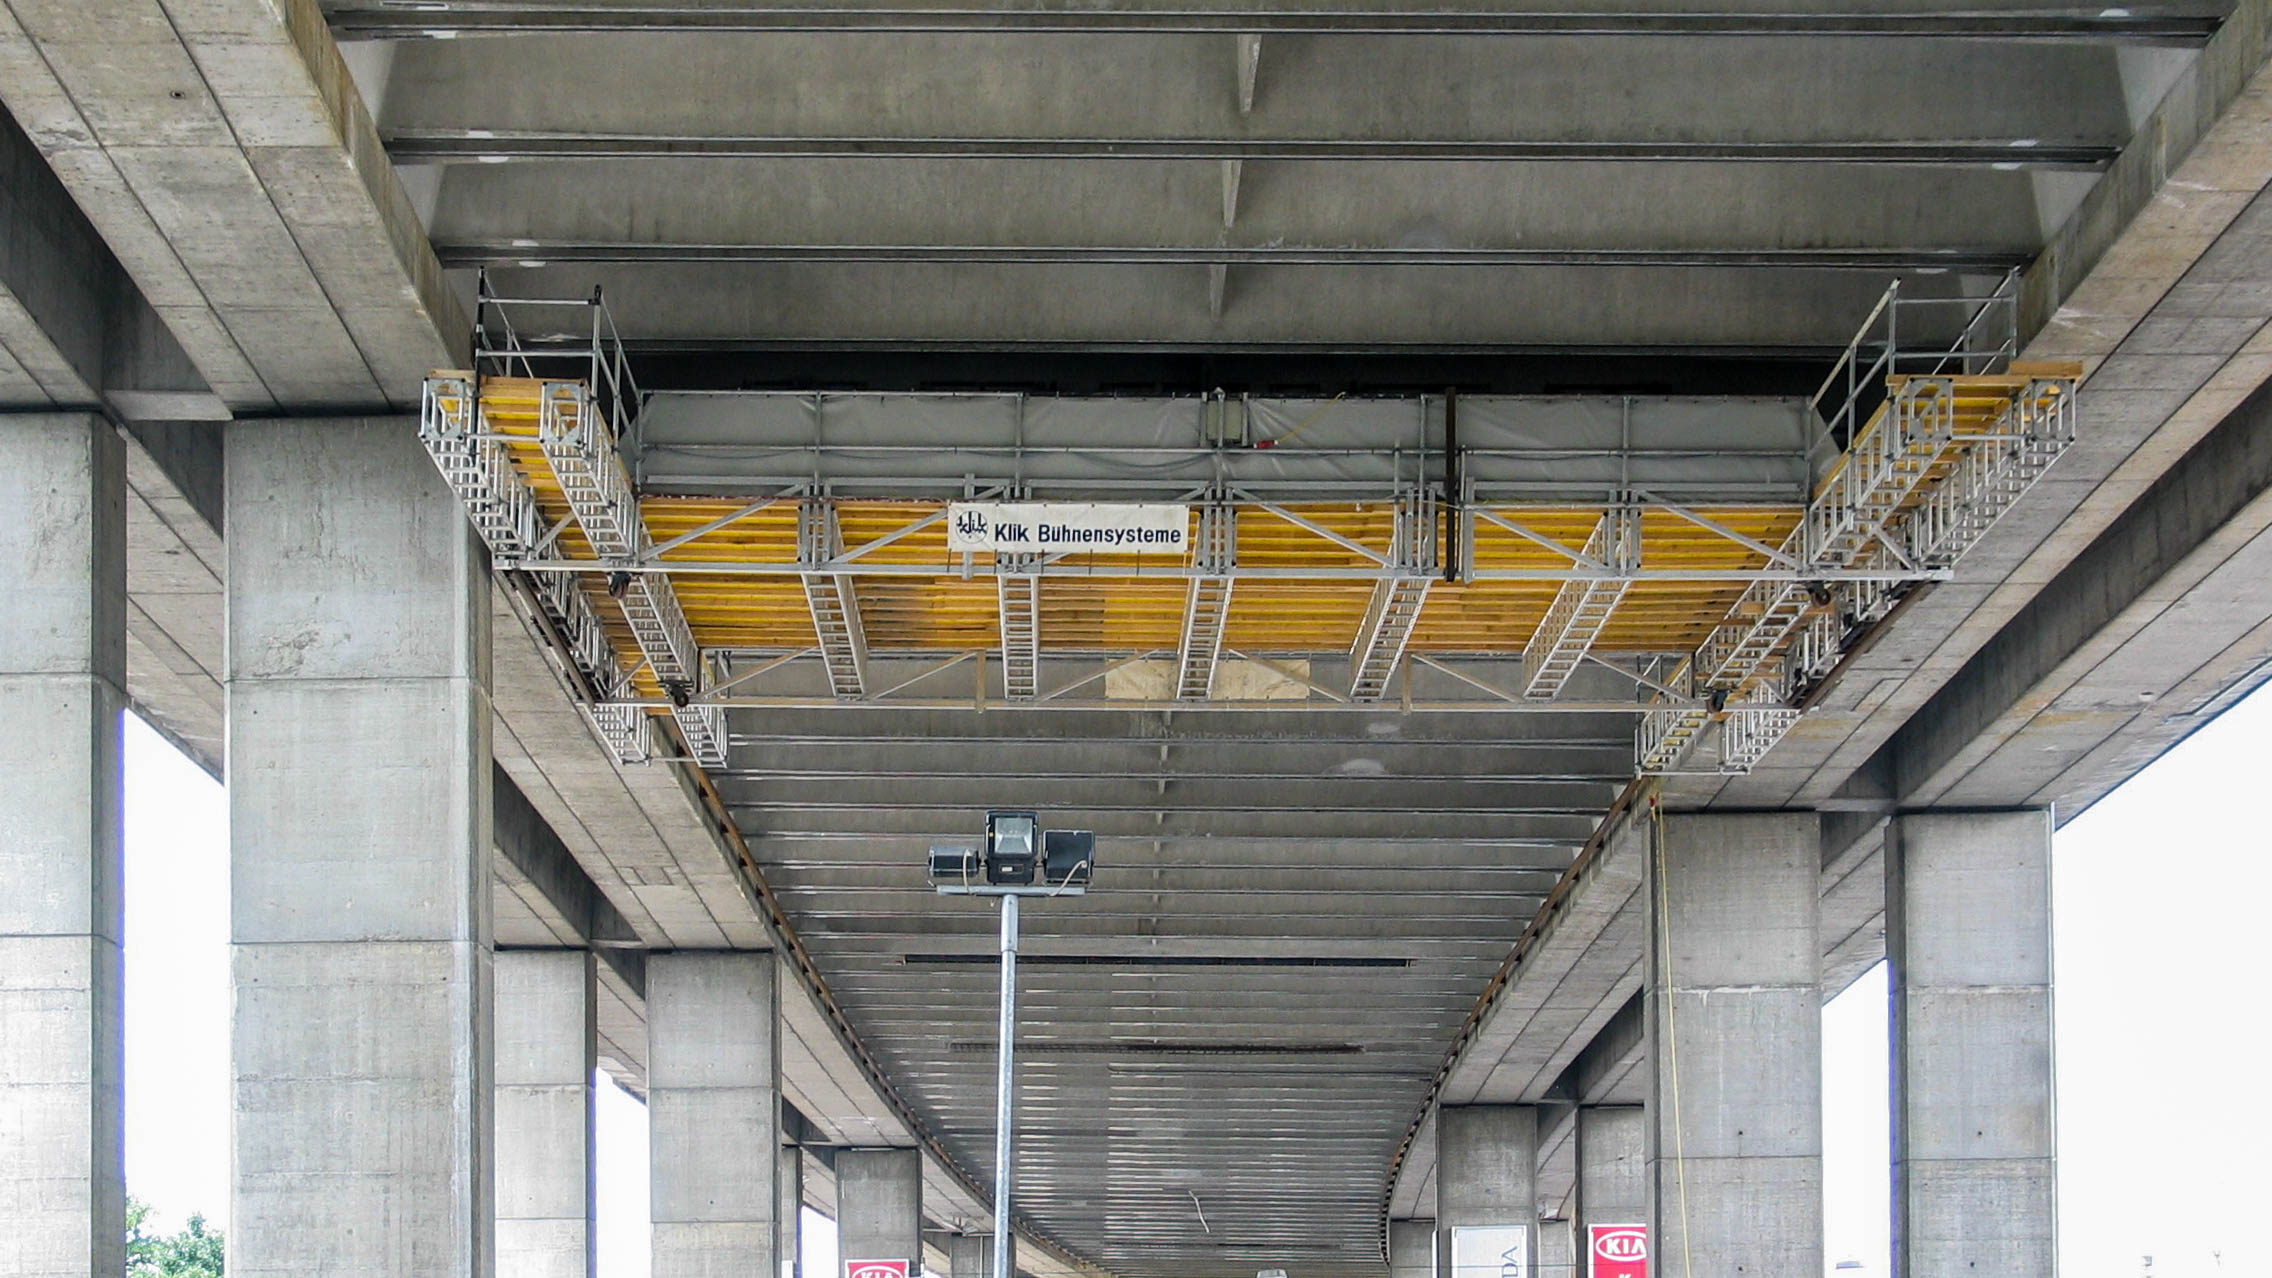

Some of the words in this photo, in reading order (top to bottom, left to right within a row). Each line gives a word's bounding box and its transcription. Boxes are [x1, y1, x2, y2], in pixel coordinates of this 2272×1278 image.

[994, 523, 1030, 542] Klik
[1038, 524, 1181, 545] Bühnensysteme
[1607, 1238, 1647, 1254] KIA
